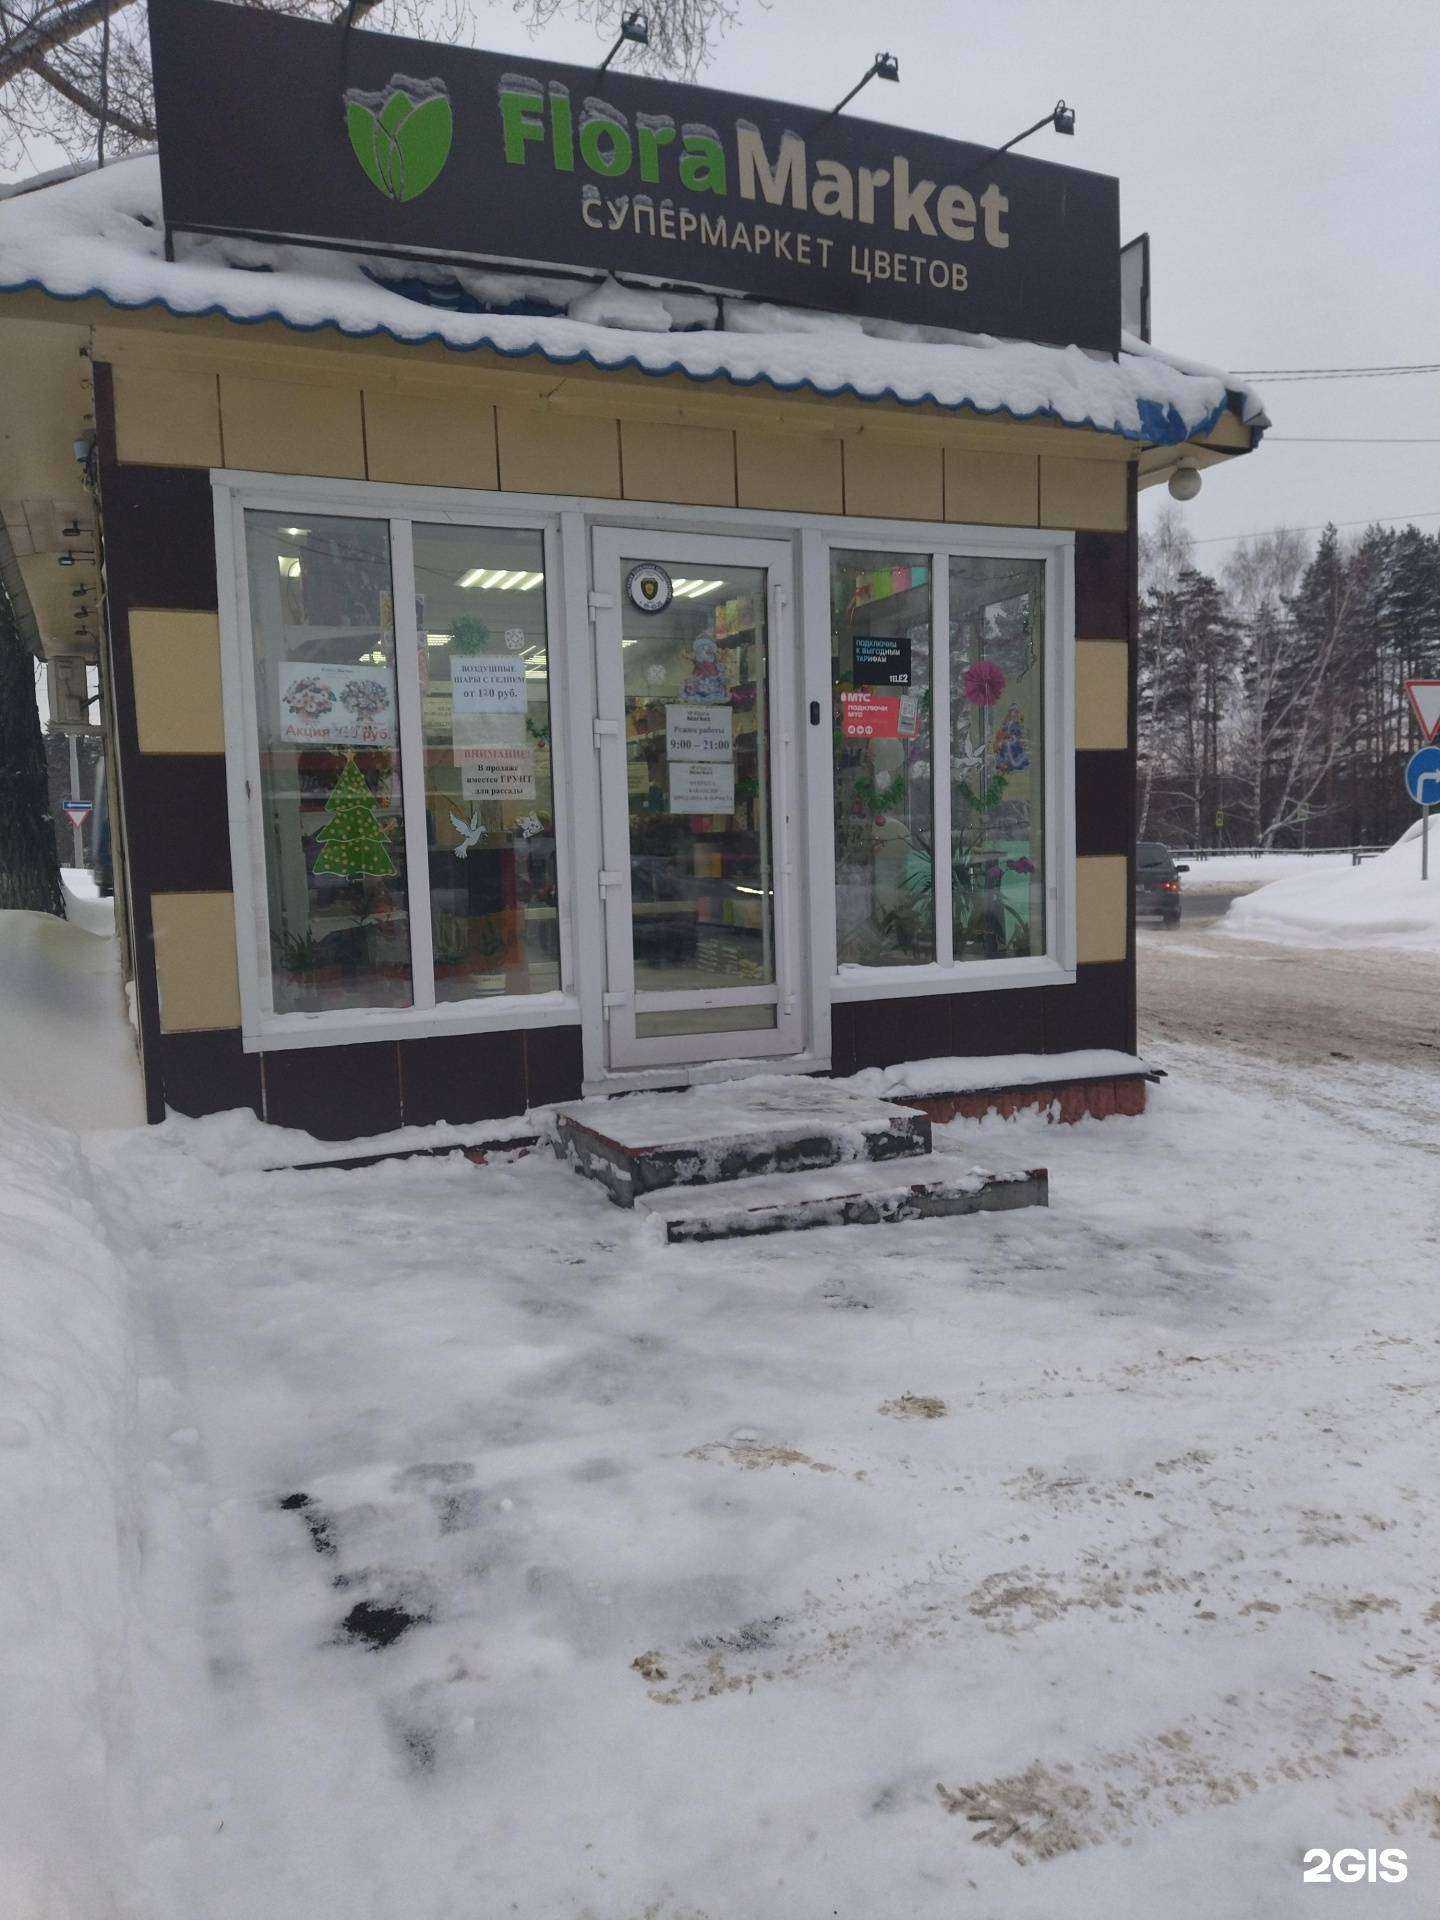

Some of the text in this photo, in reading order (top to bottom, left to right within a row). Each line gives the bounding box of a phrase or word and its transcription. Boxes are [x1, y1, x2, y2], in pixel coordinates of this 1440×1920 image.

[581, 197, 969, 292] СУПЕРМАРКЕТ ЦВЕТОВ
[889, 674, 908, 683] TELE2
[463, 690, 475, 698] от
[497, 688, 518, 701] руб.
[847, 693, 871, 702] МТС
[286, 724, 330, 738] Акция
[670, 739, 692, 750] 9:00
[703, 740, 730, 751] 21:00
